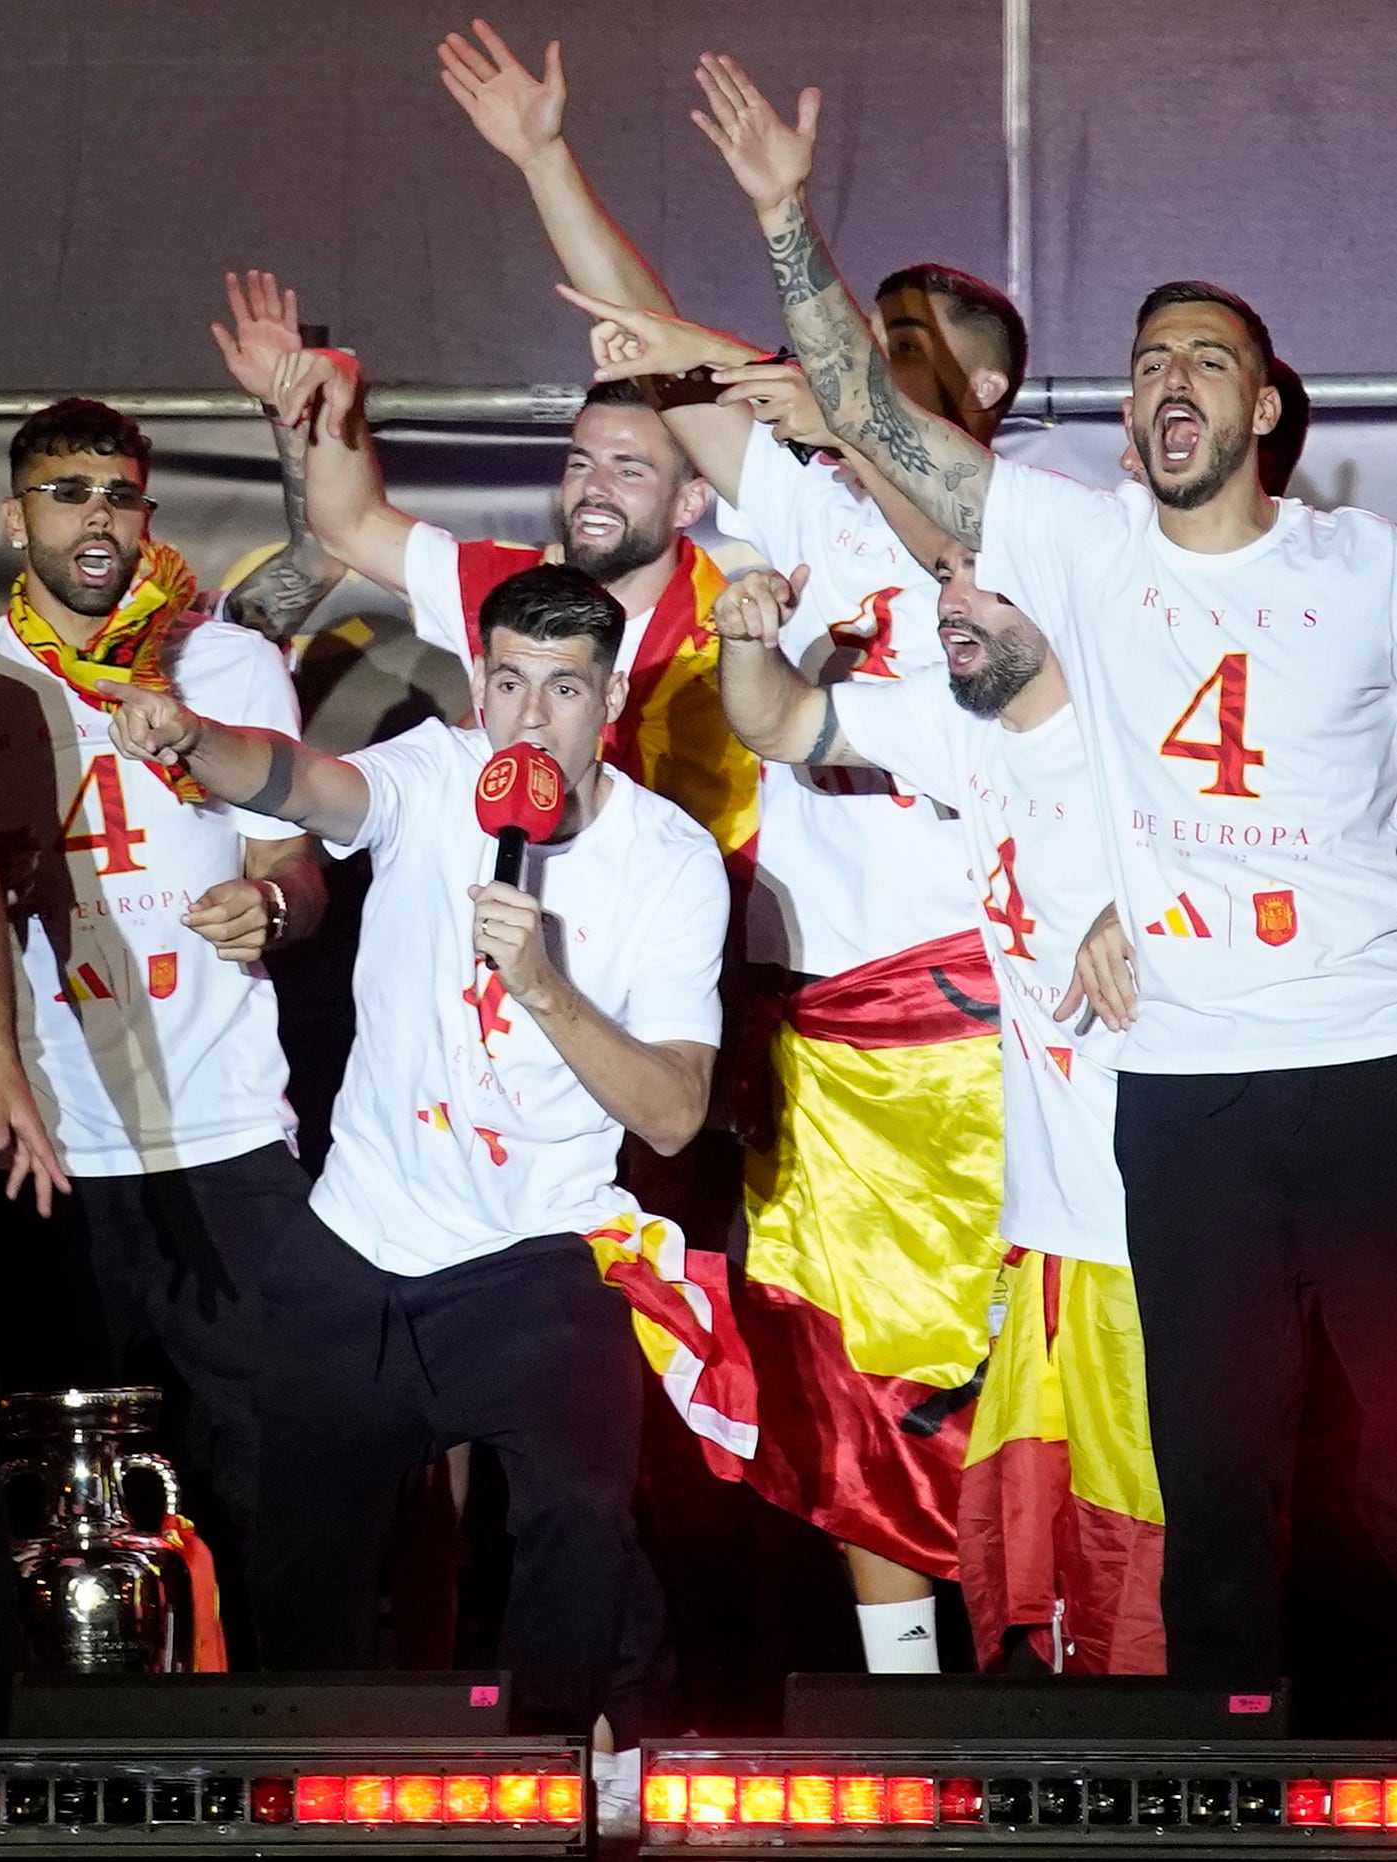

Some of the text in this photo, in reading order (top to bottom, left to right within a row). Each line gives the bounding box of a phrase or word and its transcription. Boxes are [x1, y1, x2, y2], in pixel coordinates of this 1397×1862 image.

[836, 529, 901, 564] REY
[1142, 587, 1318, 628] REYES
[1159, 652, 1264, 798] 4
[58, 754, 147, 876] 4
[1132, 809, 1310, 847] DE EUROPA
[75, 889, 194, 919] EUROPA
[983, 835, 1037, 961] 4
